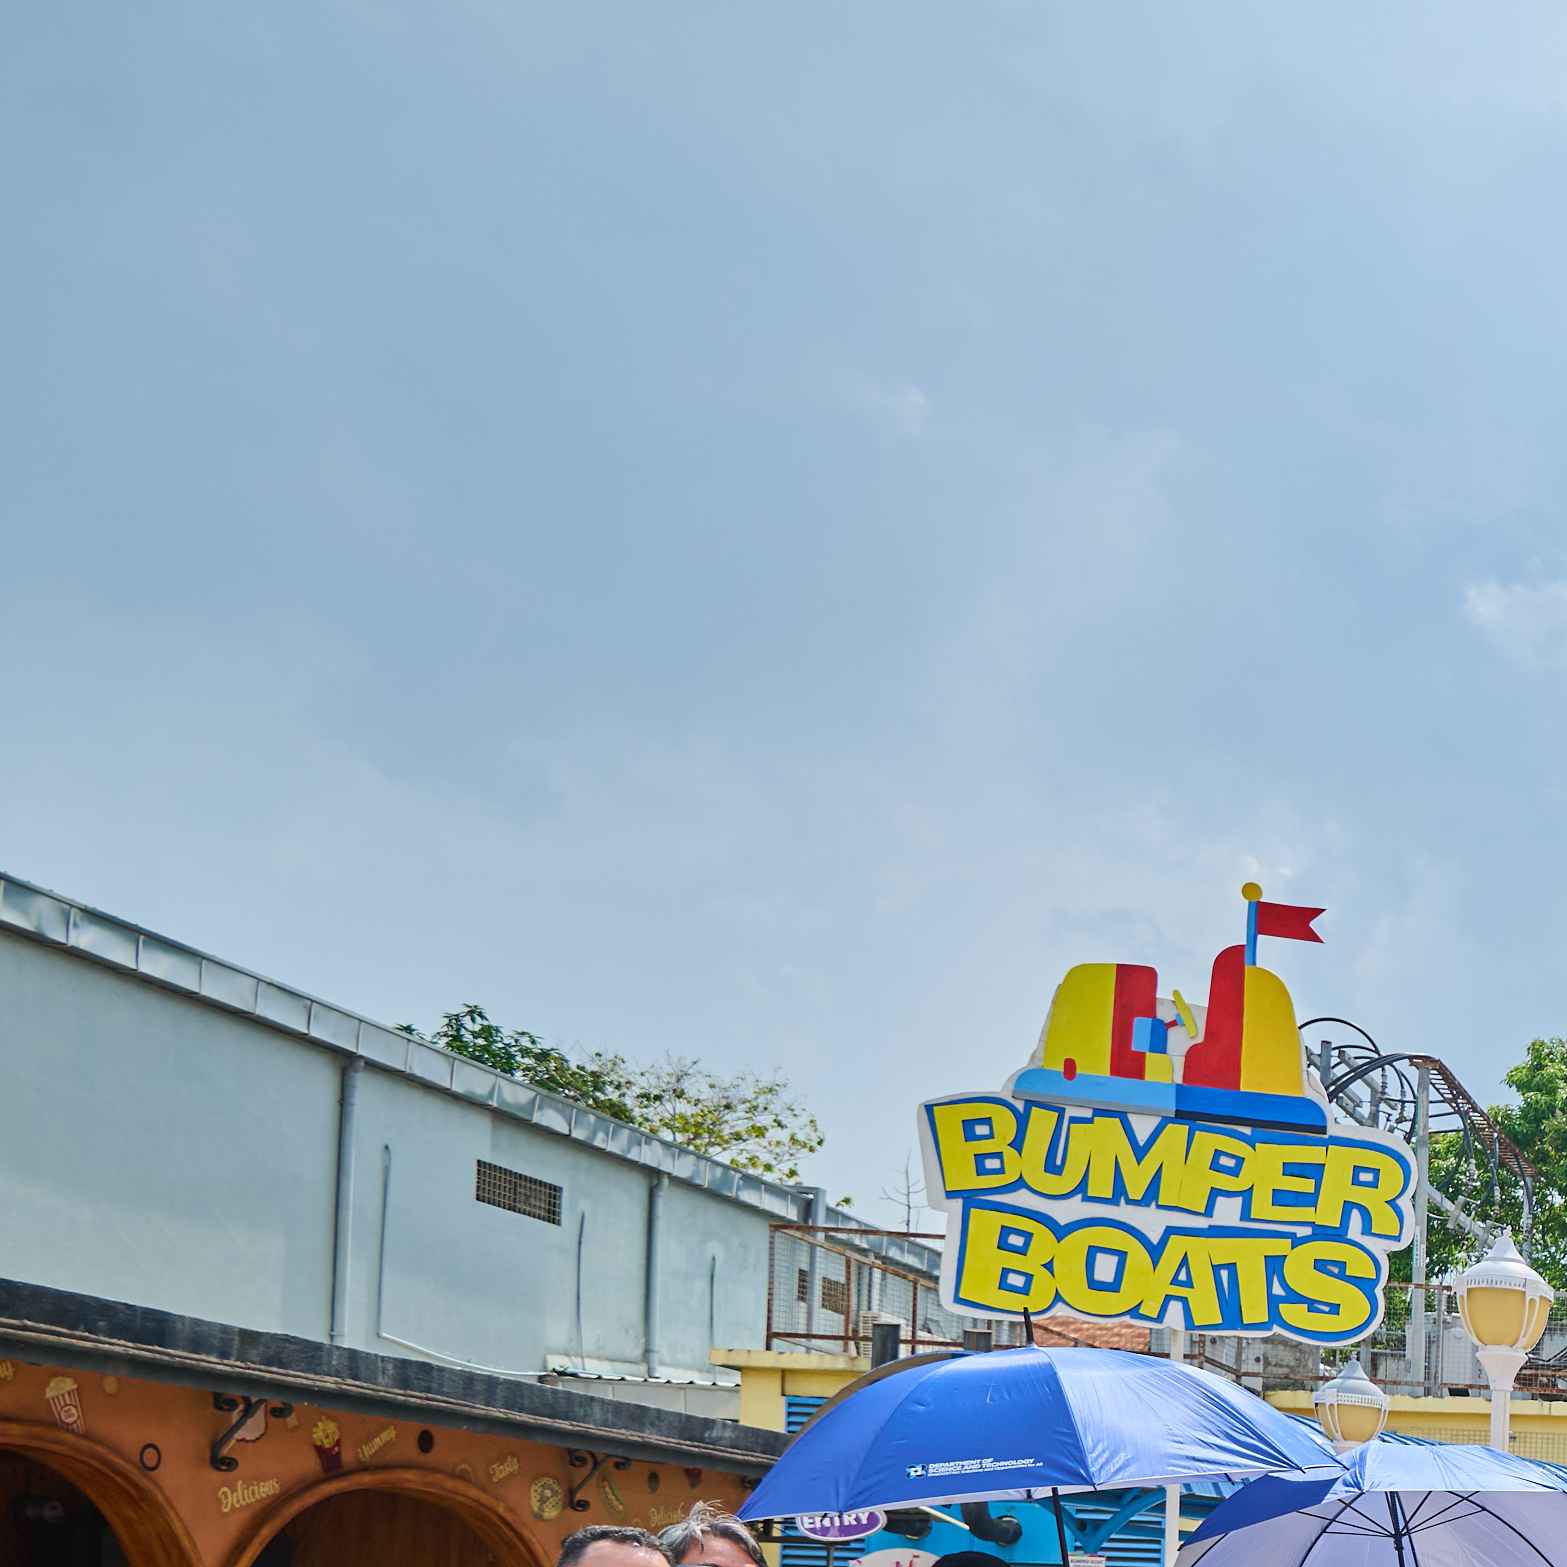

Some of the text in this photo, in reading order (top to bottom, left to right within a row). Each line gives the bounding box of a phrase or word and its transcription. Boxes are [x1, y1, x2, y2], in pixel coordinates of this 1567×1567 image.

[927, 1098, 1408, 1240] BUMPER
[956, 1203, 1379, 1337] BOATS
[218, 1478, 280, 1512] Delicious
